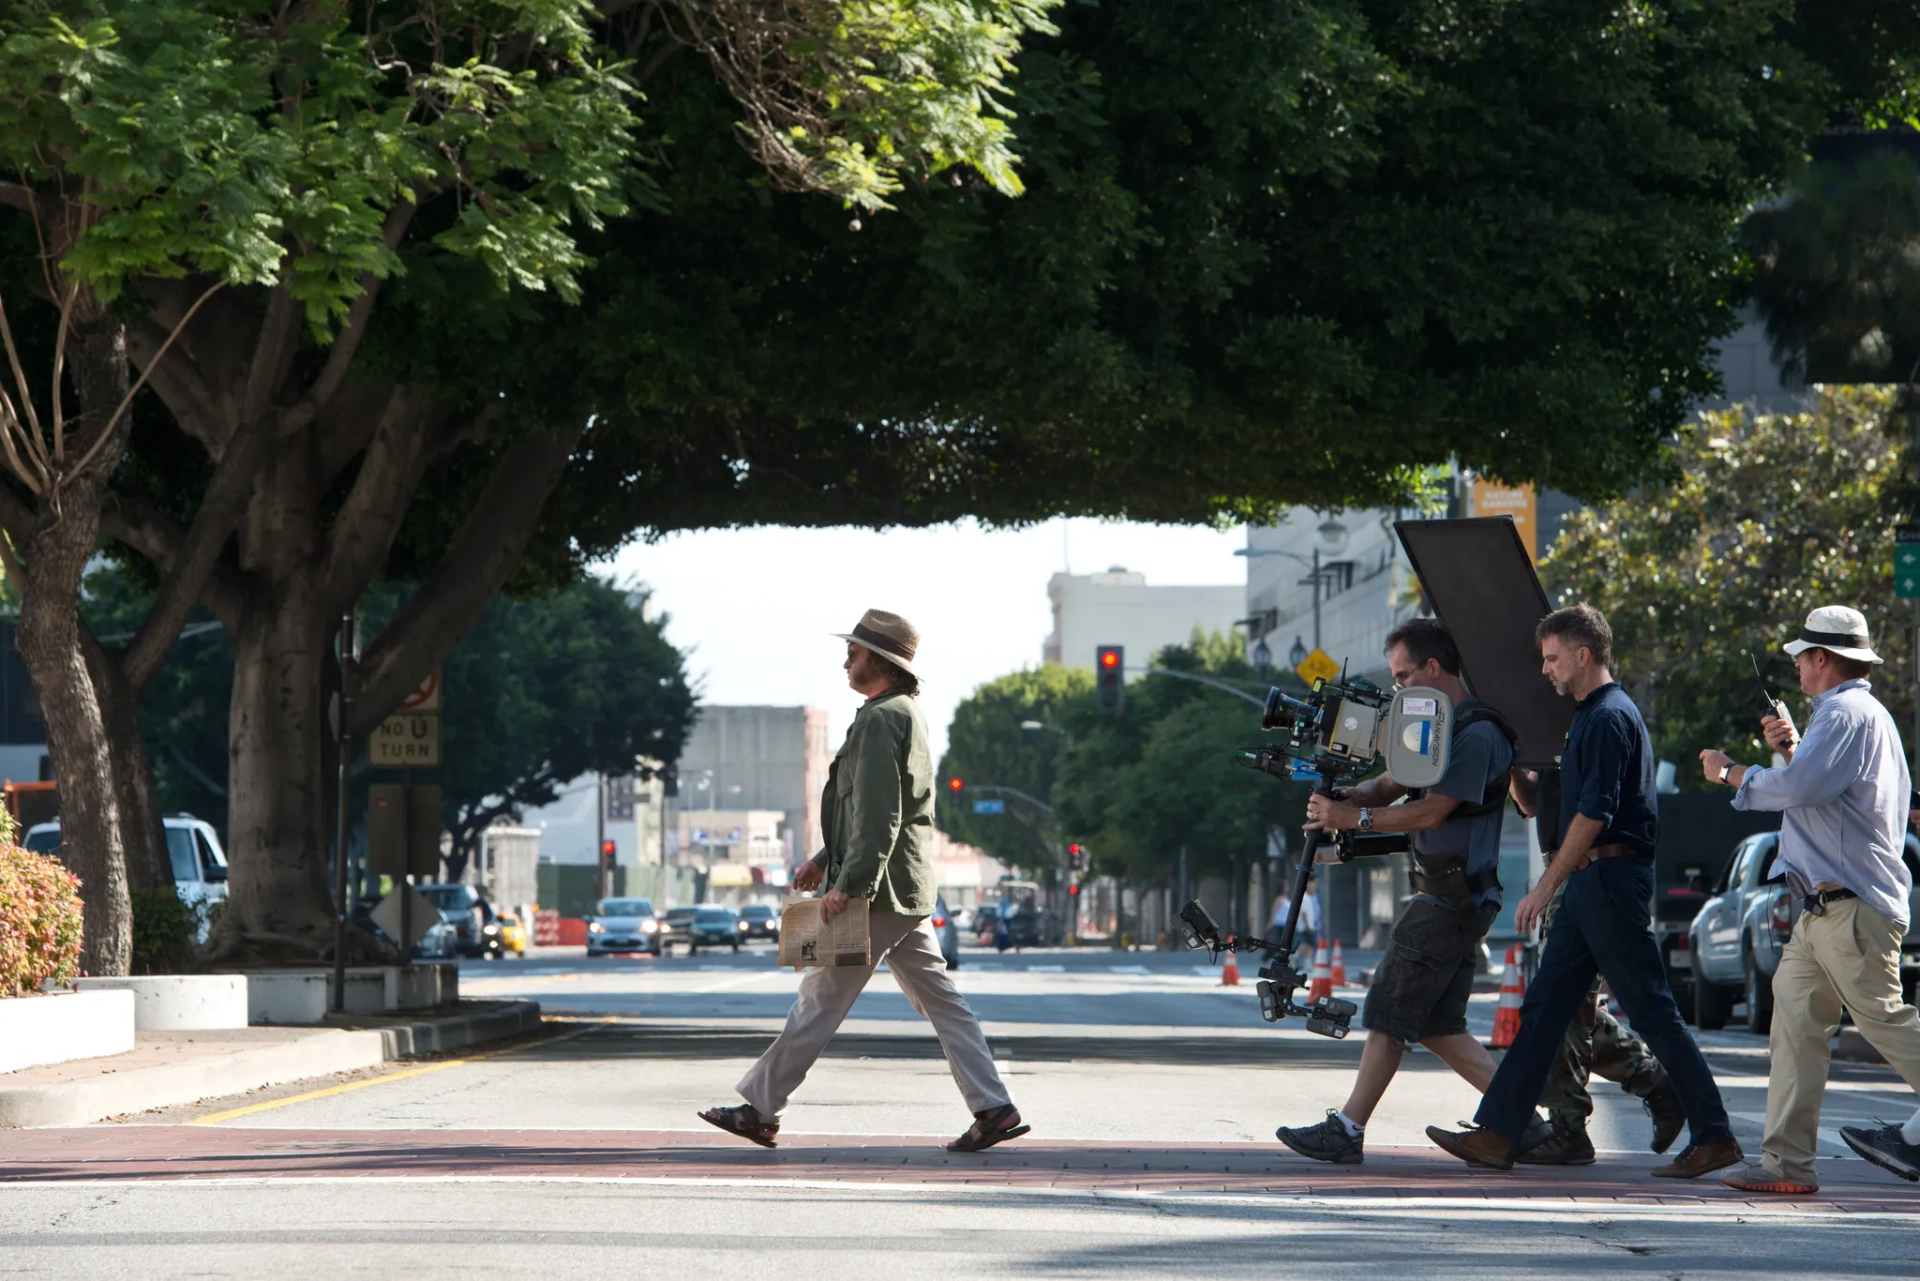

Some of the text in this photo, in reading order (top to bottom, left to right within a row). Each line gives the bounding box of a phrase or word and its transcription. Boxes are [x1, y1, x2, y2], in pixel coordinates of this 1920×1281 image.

[380, 719, 428, 739] NO U
[1432, 707, 1445, 767] PANAVISION
[380, 743, 429, 757] TURN
